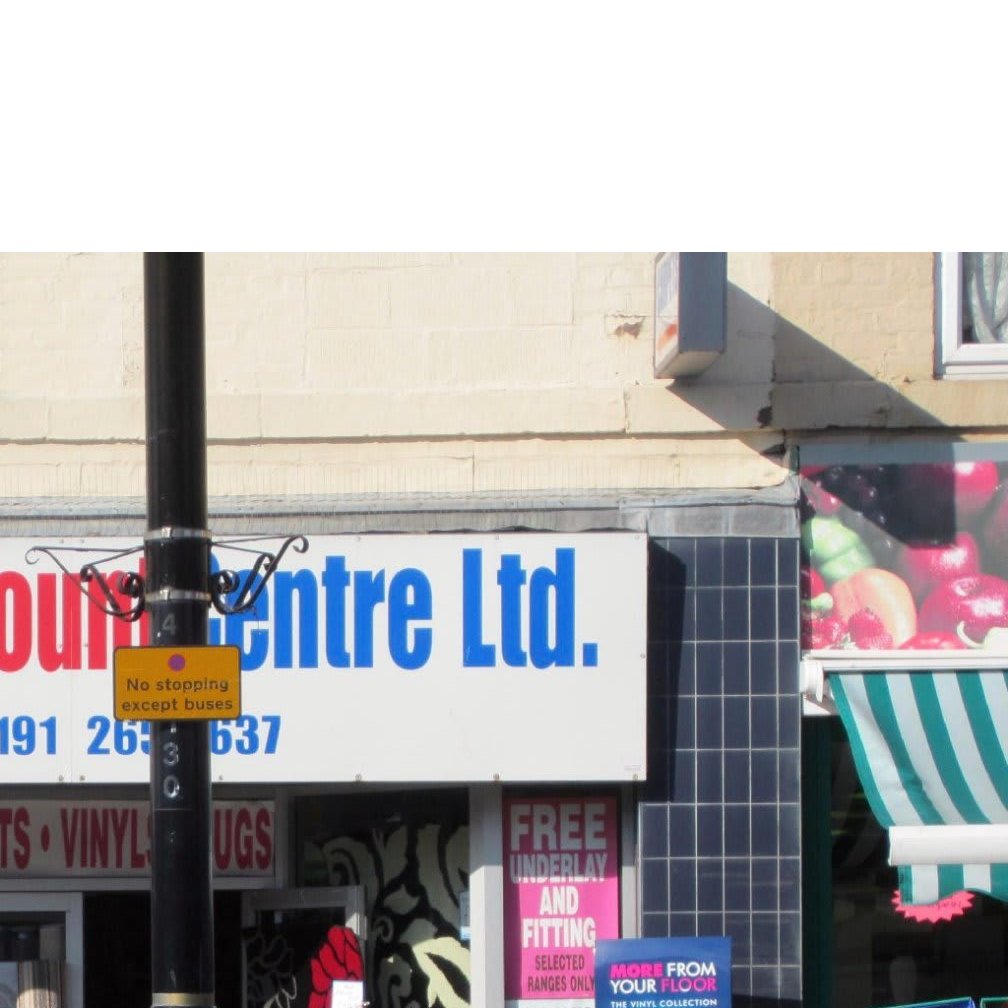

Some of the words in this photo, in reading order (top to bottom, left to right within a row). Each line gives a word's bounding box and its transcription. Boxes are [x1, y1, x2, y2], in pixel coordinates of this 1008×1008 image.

[209, 551, 433, 671] entre
[462, 548, 598, 670] Ltd.
[126, 678, 149, 692] No
[156, 677, 229, 693] stopping
[122, 700, 178, 713] except
[184, 699, 233, 711] buses
[210, 714, 281, 756] 637
[510, 803, 607, 851] FREE
[60, 808, 151, 869] VINYL
[214, 808, 273, 870] UGS
[510, 853, 607, 884] UNDERLAY
[539, 886, 580, 915] AND
[522, 917, 597, 948] FITTING
[535, 955, 585, 971] SELECTED
[611, 963, 663, 979] MORE
[667, 961, 716, 977] FROM
[527, 976, 567, 992] RANGES
[610, 978, 657, 994] YOUR
[661, 977, 717, 992] FLOOR
[611, 1001, 627, 1008] THE
[631, 1000, 657, 1008] VINYL
[659, 998, 718, 1008] COLLECTION
